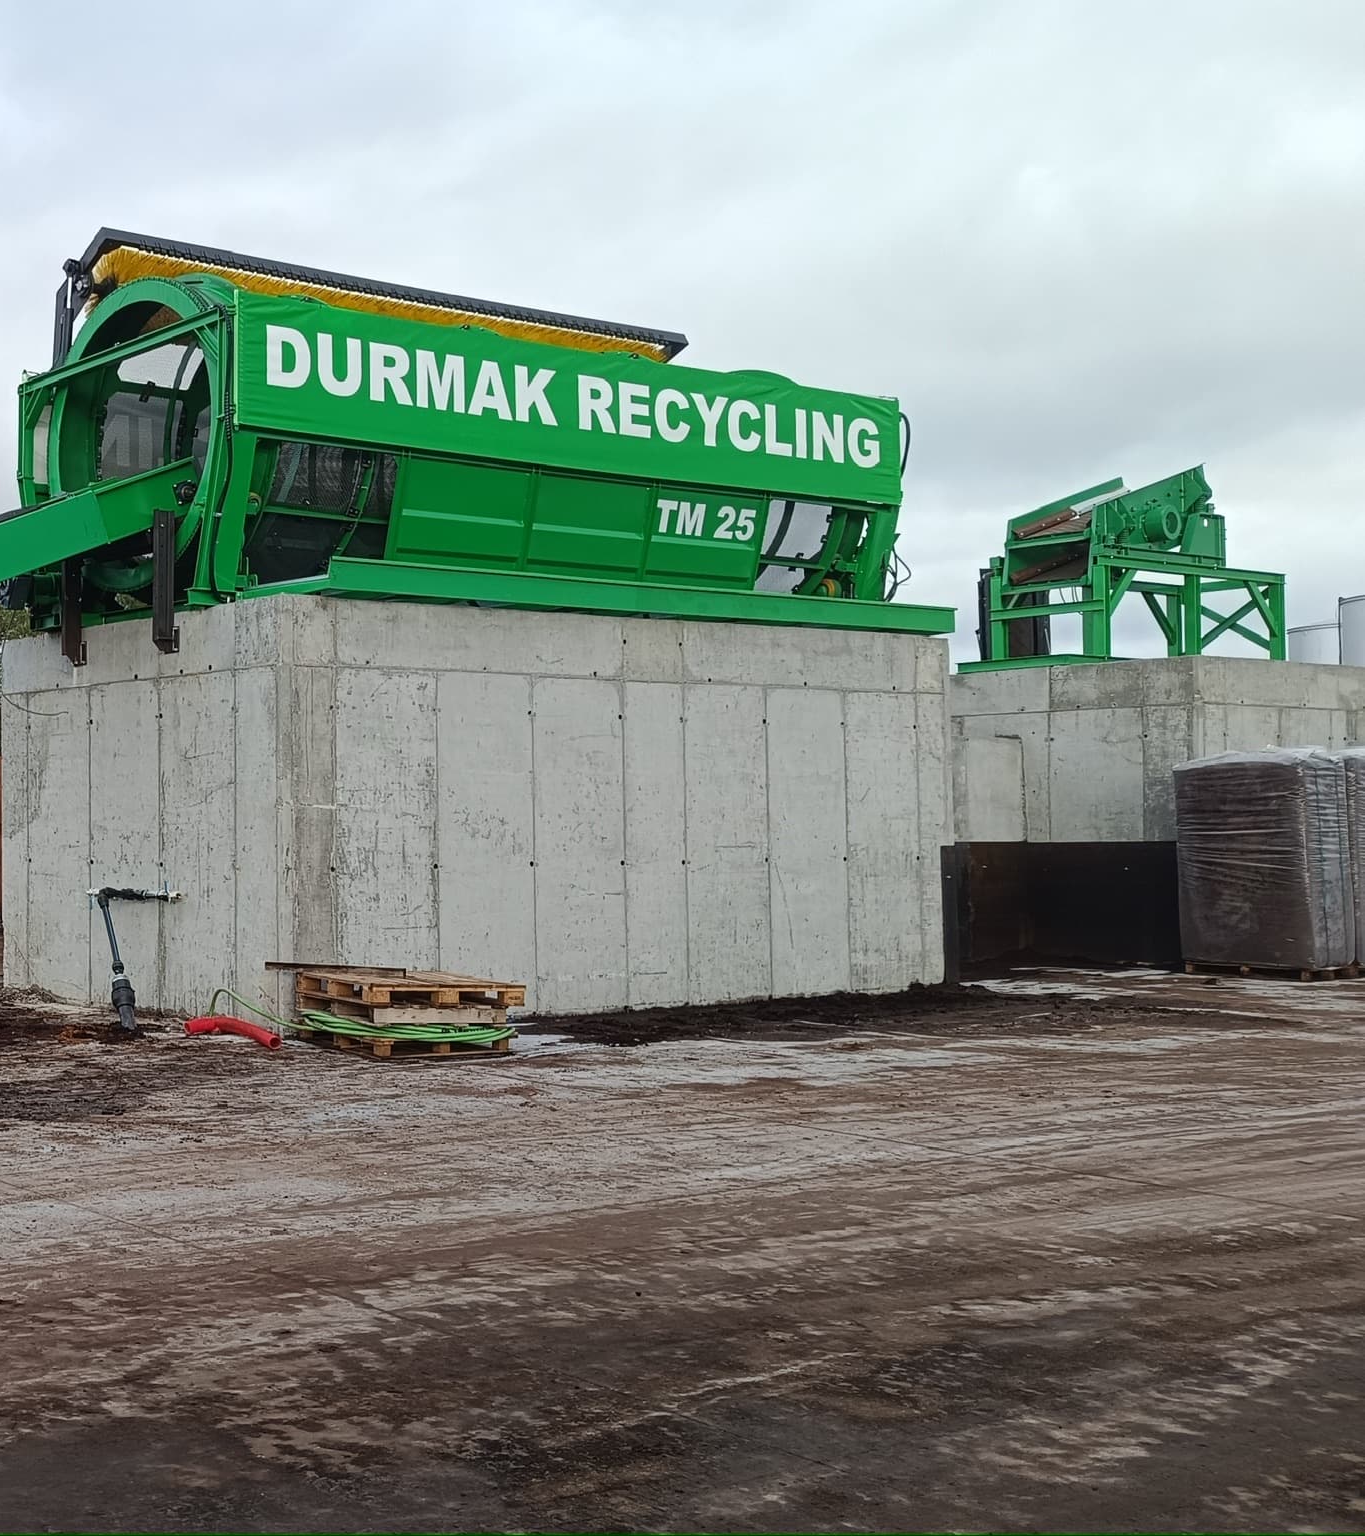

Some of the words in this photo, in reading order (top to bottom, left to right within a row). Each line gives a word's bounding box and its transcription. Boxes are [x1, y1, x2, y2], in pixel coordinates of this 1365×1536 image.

[266, 325, 558, 426] DURMAK
[578, 375, 881, 468] RECYCLING
[656, 499, 706, 536] TM
[714, 506, 757, 541] 25
